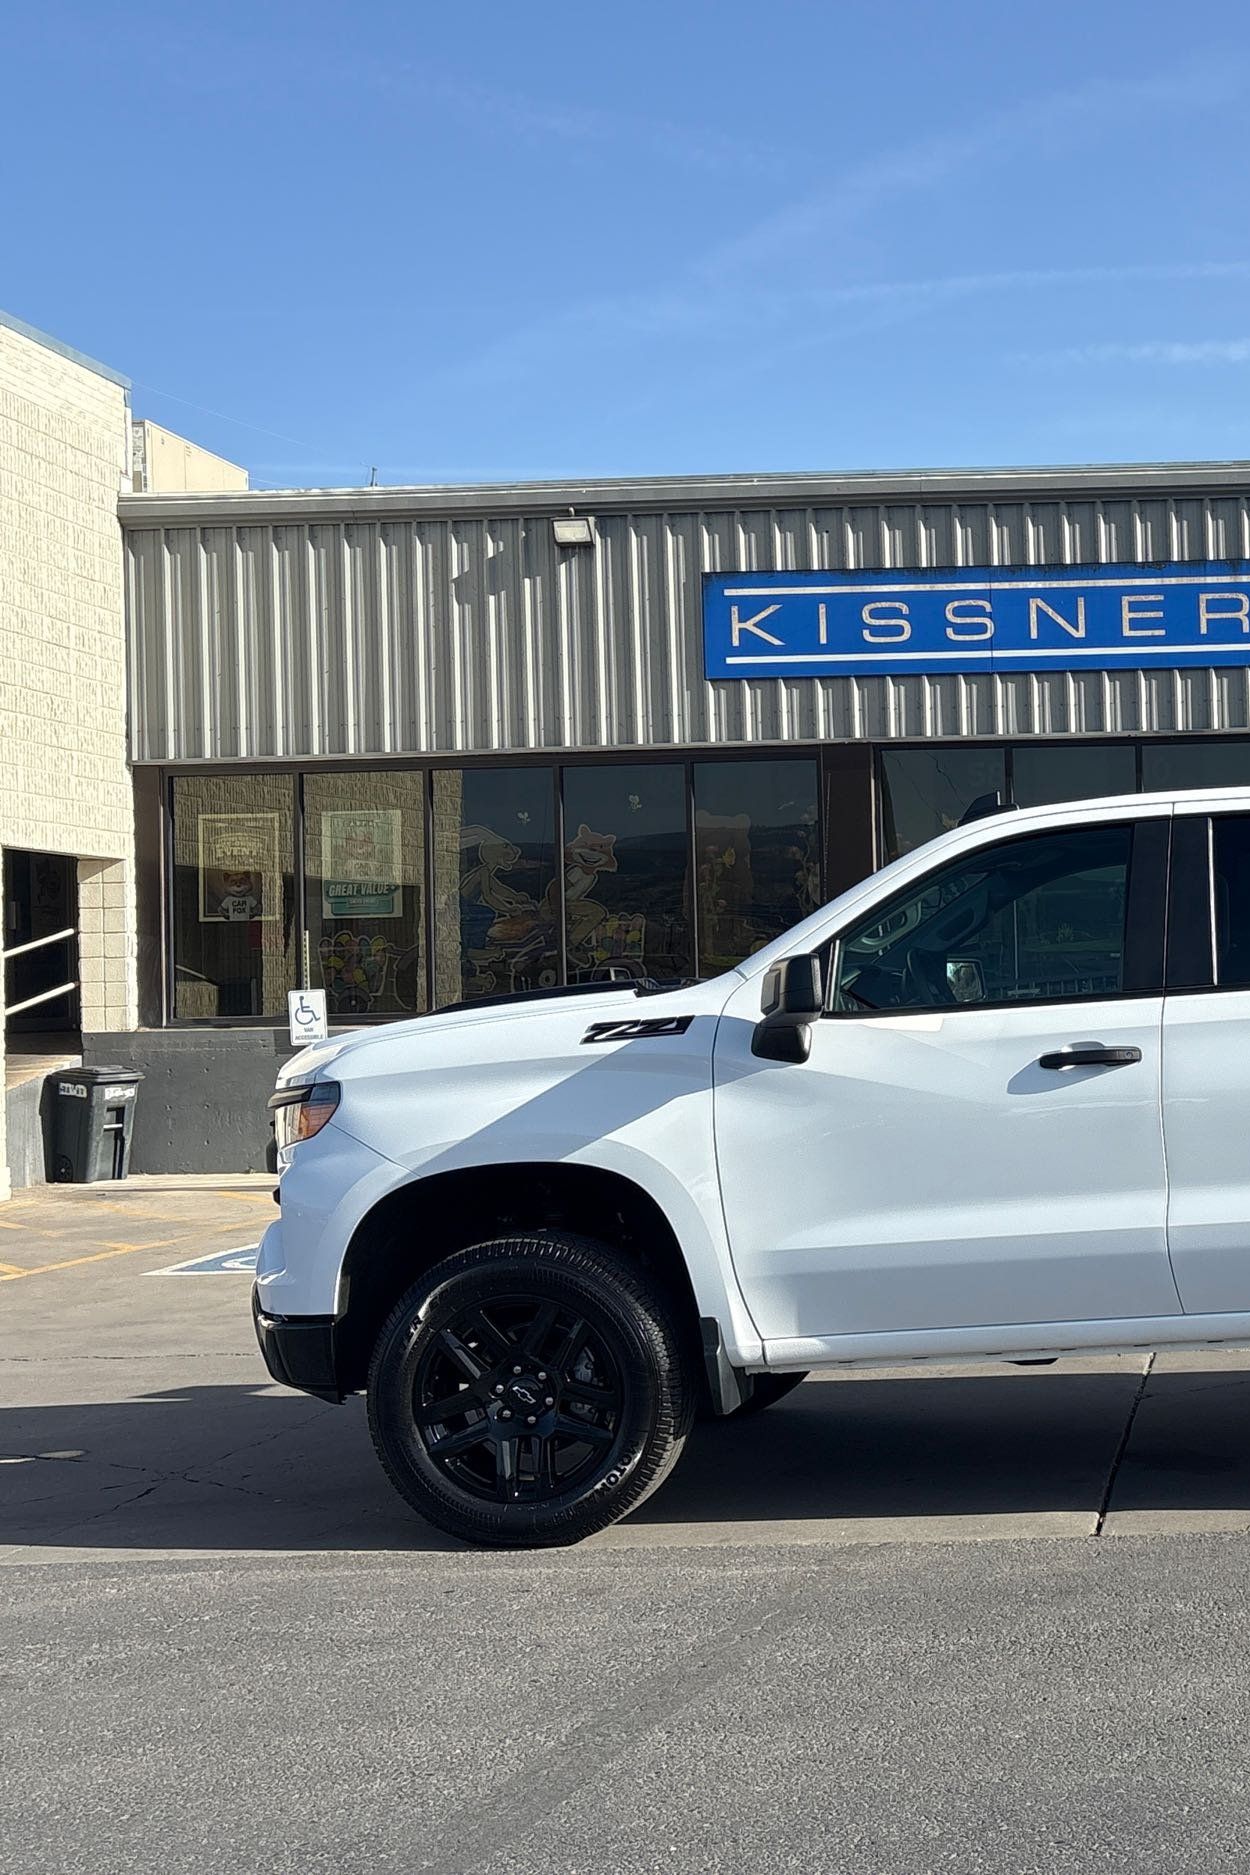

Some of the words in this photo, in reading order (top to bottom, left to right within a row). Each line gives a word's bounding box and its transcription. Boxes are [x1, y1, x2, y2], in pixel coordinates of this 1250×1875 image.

[731, 592, 1250, 648] KISSNER
[328, 883, 358, 897] GREAT
[360, 882, 390, 896] VALUE
